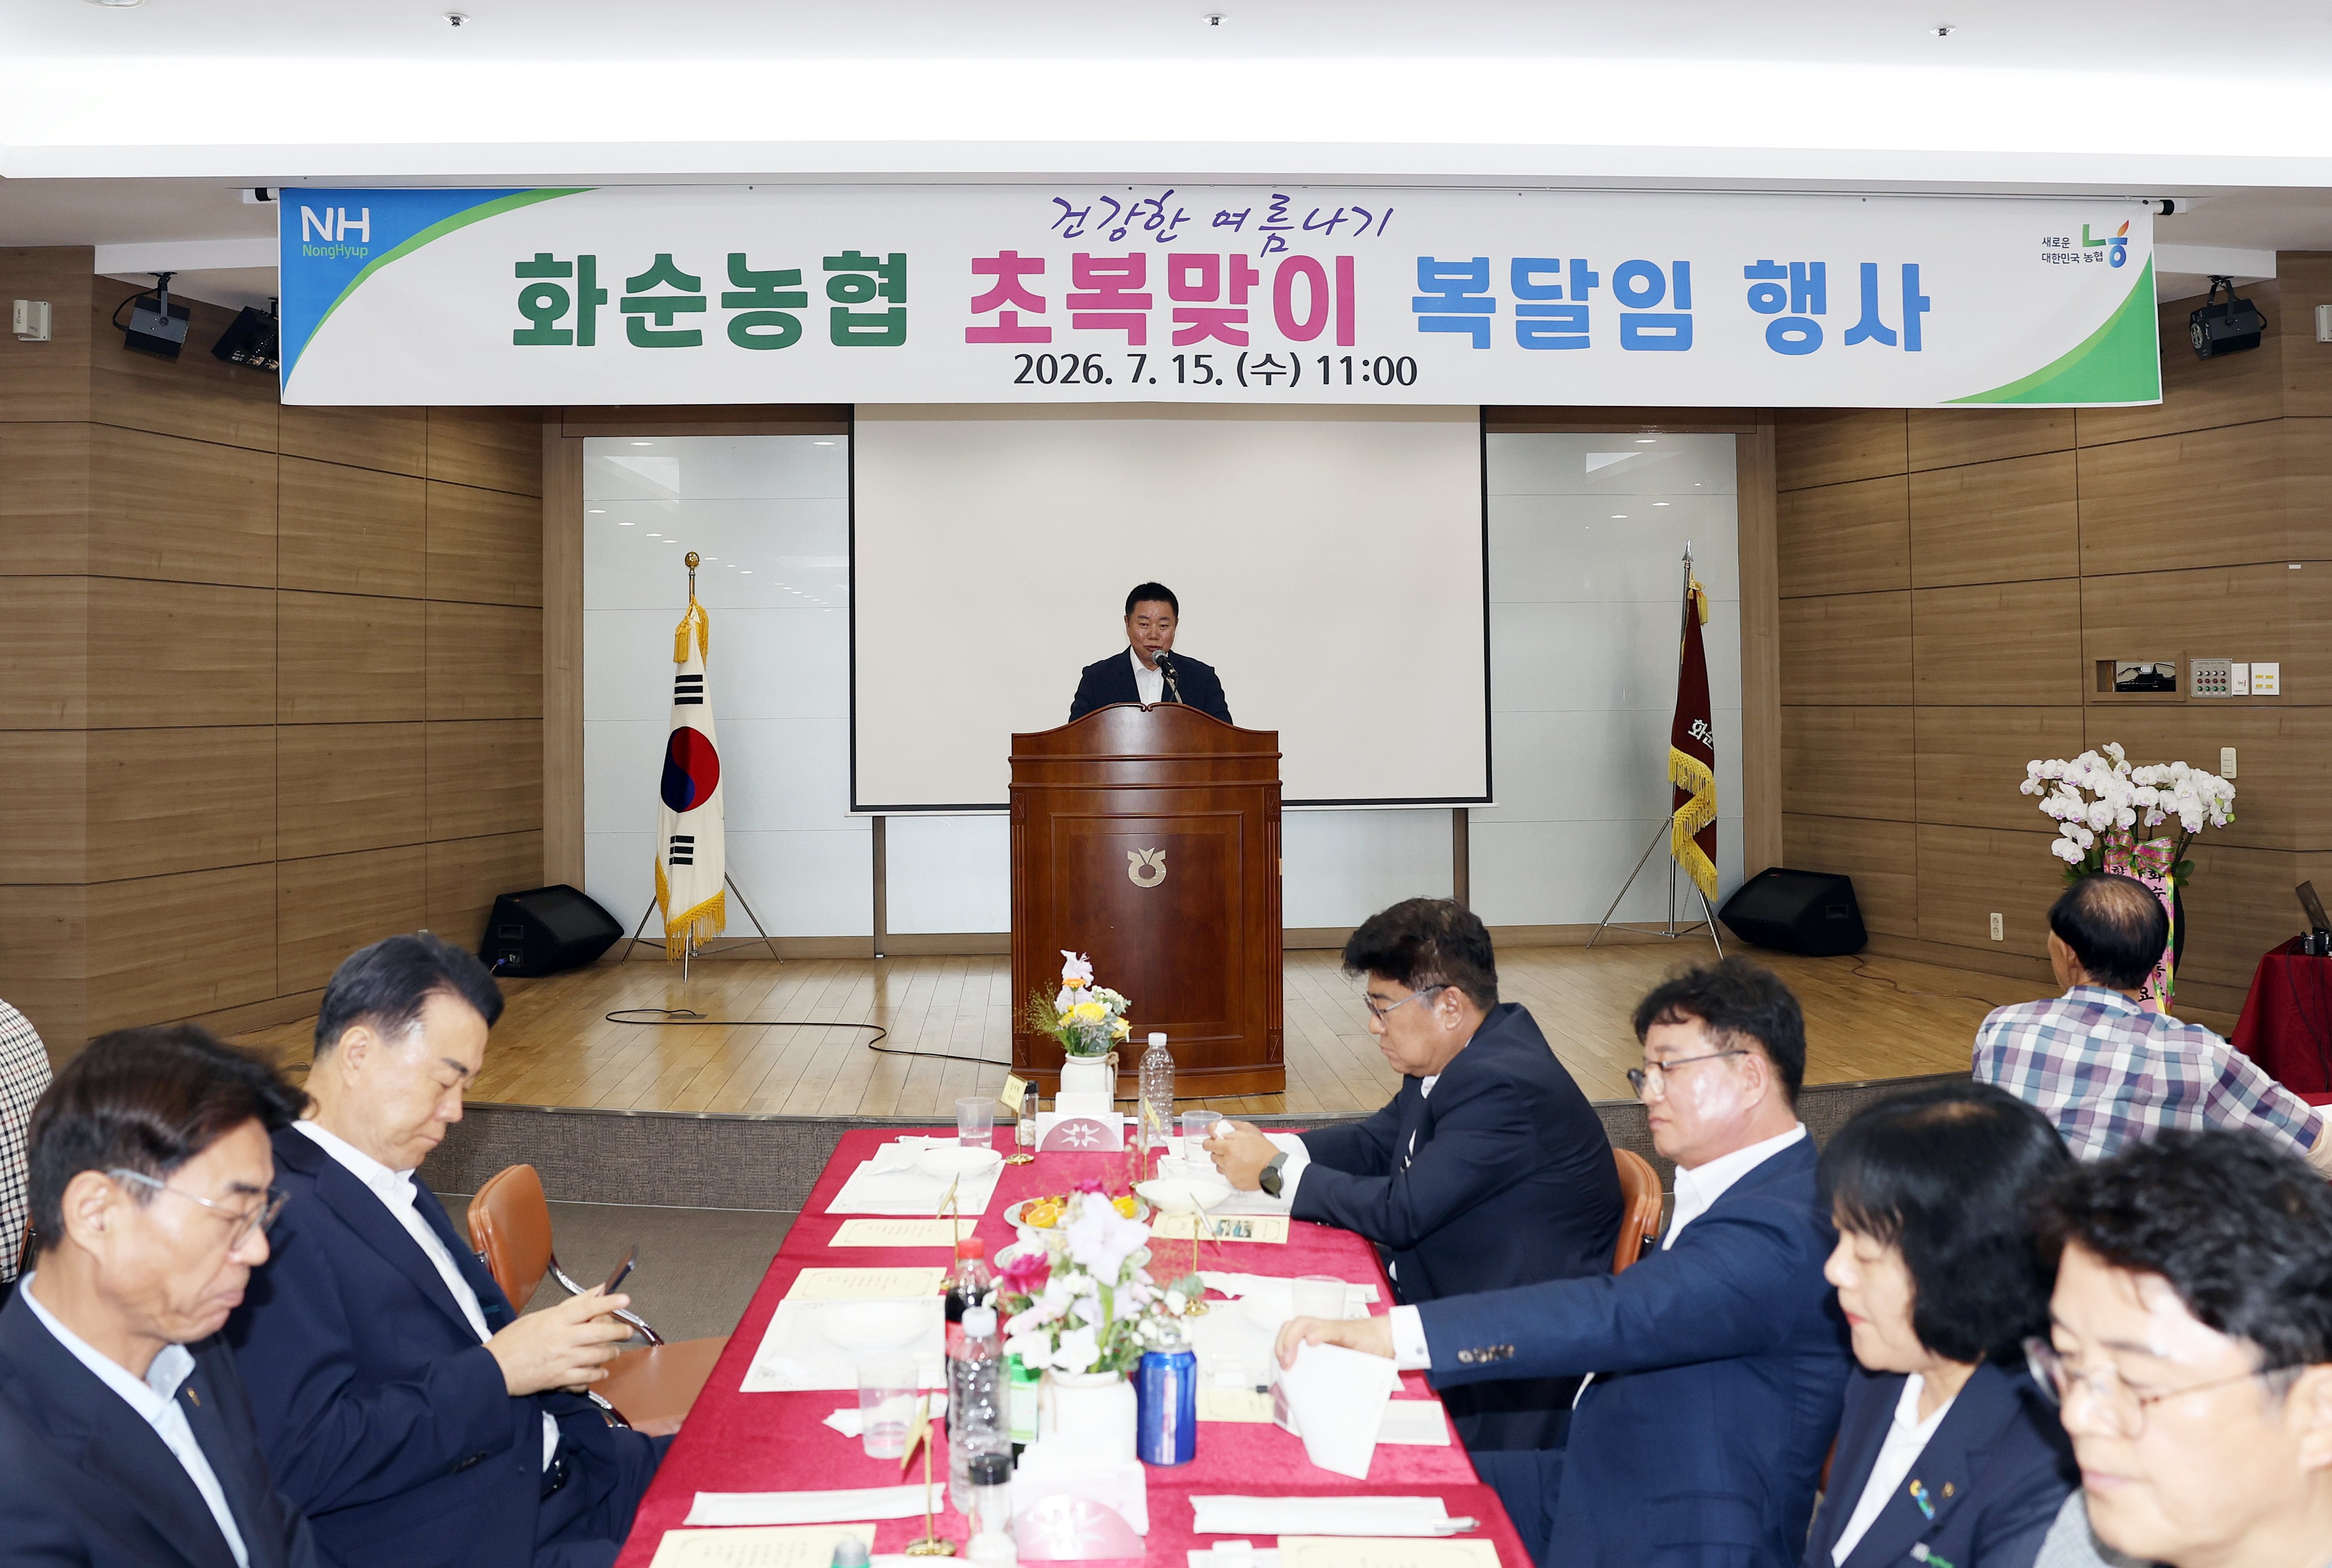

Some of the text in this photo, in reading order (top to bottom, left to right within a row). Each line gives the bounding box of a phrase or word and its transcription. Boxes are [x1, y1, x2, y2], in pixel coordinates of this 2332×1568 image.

[301, 205, 370, 242] NH
[1051, 189, 1394, 258] 건강한 여름나기
[302, 244, 369, 259] NongHyup
[2041, 236, 2070, 249] 새로운
[2041, 251, 2104, 264] 대한민국 농협
[513, 250, 1931, 356] 화순농협 초복맞이 복달임 행사
[1013, 351, 1418, 388] 2026. 7. 15. (수) 11:00
